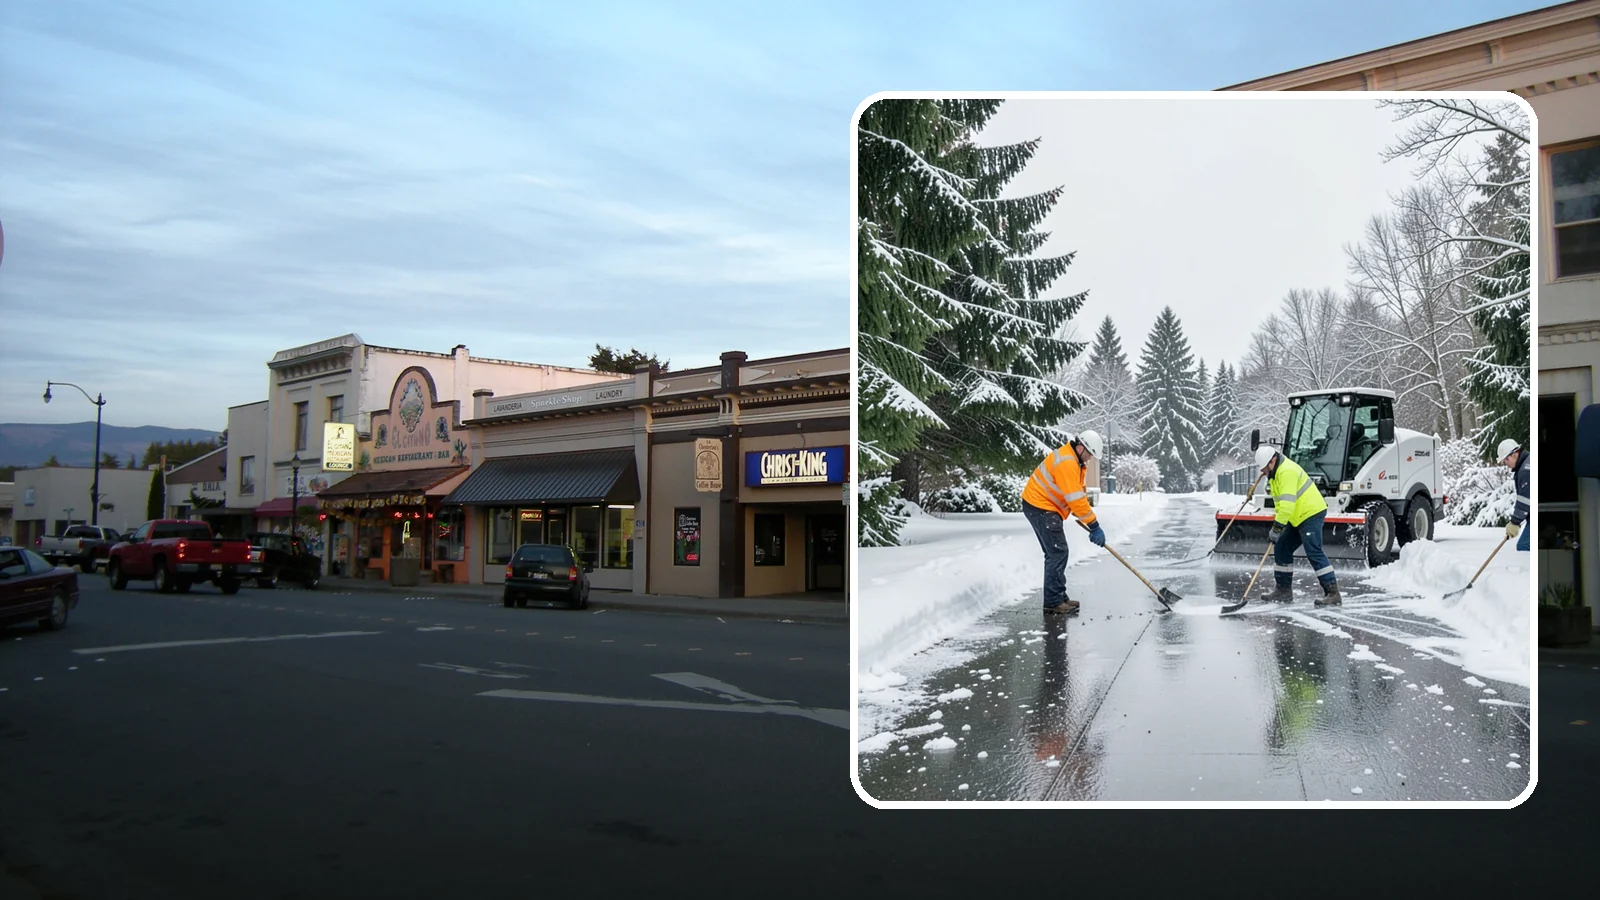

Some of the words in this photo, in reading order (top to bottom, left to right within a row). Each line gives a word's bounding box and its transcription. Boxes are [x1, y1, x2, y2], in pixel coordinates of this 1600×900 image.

[595, 389, 624, 400] LAUNDRY
[493, 401, 523, 413] LAVANDERIA
[530, 396, 560, 409] Sparkle
[561, 395, 582, 405] Shop
[373, 454, 396, 464] MEXICAN
[397, 451, 433, 462] RESTAURANT
[437, 450, 450, 459] BAR
[761, 452, 797, 478] CHRIST
[799, 450, 827, 476] KING
